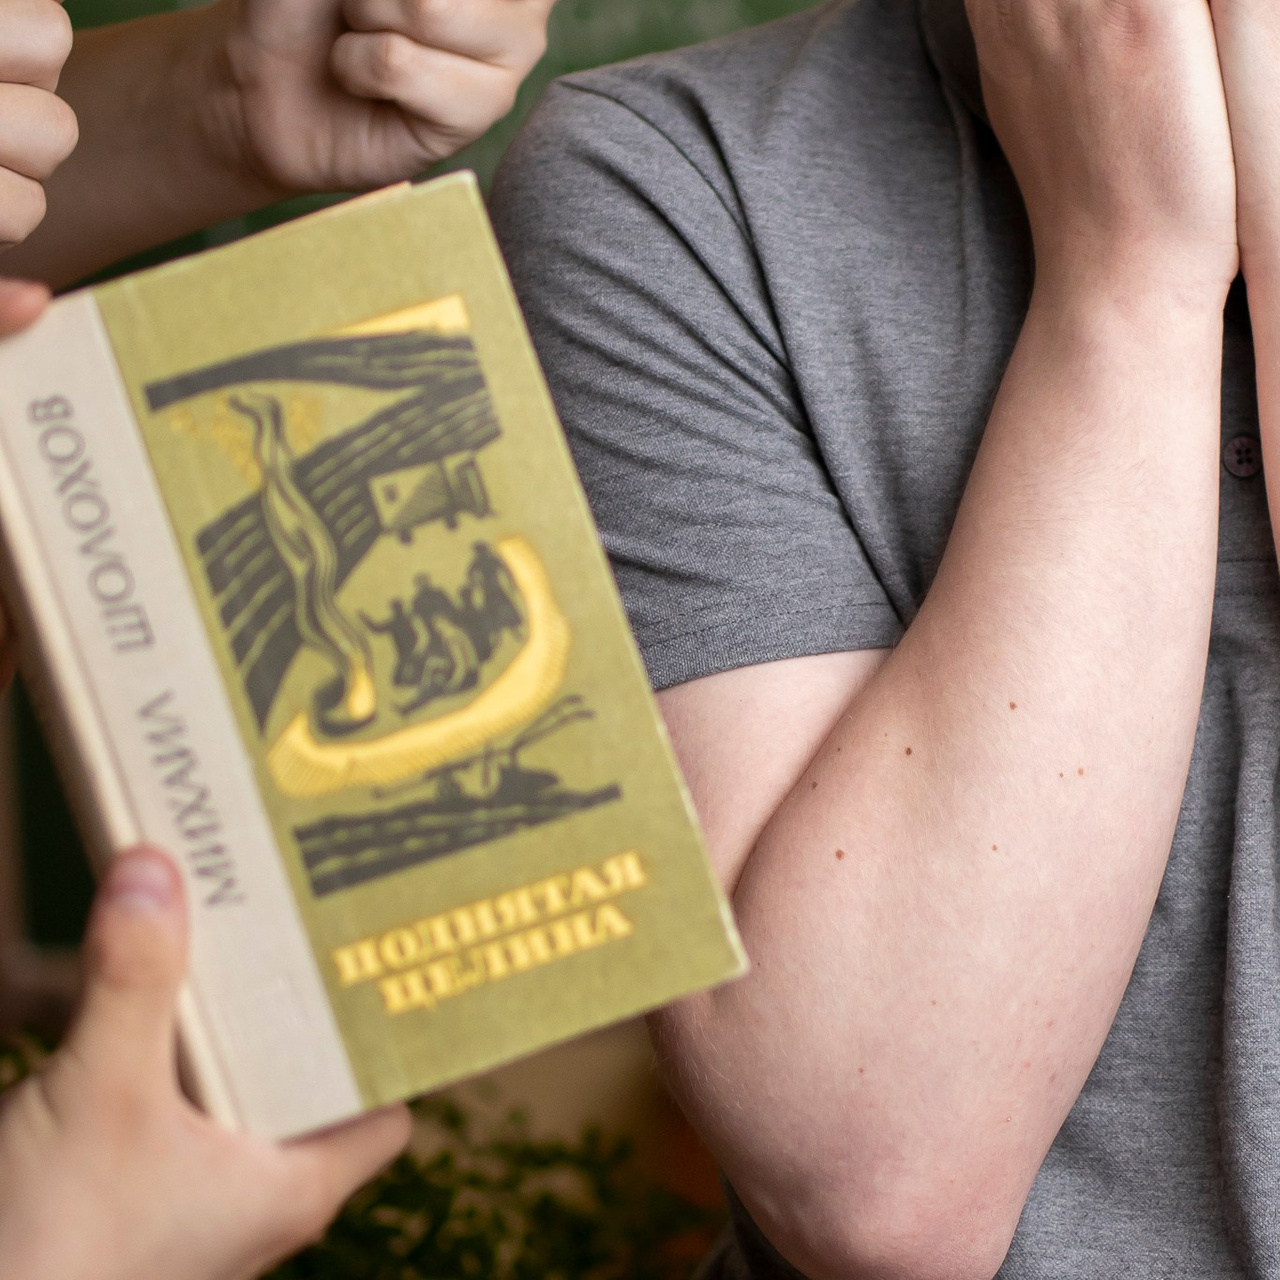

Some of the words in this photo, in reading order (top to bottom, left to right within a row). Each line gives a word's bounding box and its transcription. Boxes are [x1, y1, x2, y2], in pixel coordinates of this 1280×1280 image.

[26, 394, 155, 655] ШОЛОХОВ
[136, 689, 247, 908] МИХАИЛ
[333, 850, 646, 986] ПОДНЯТАЯ
[378, 902, 634, 1016] ЦЕЛИНА
